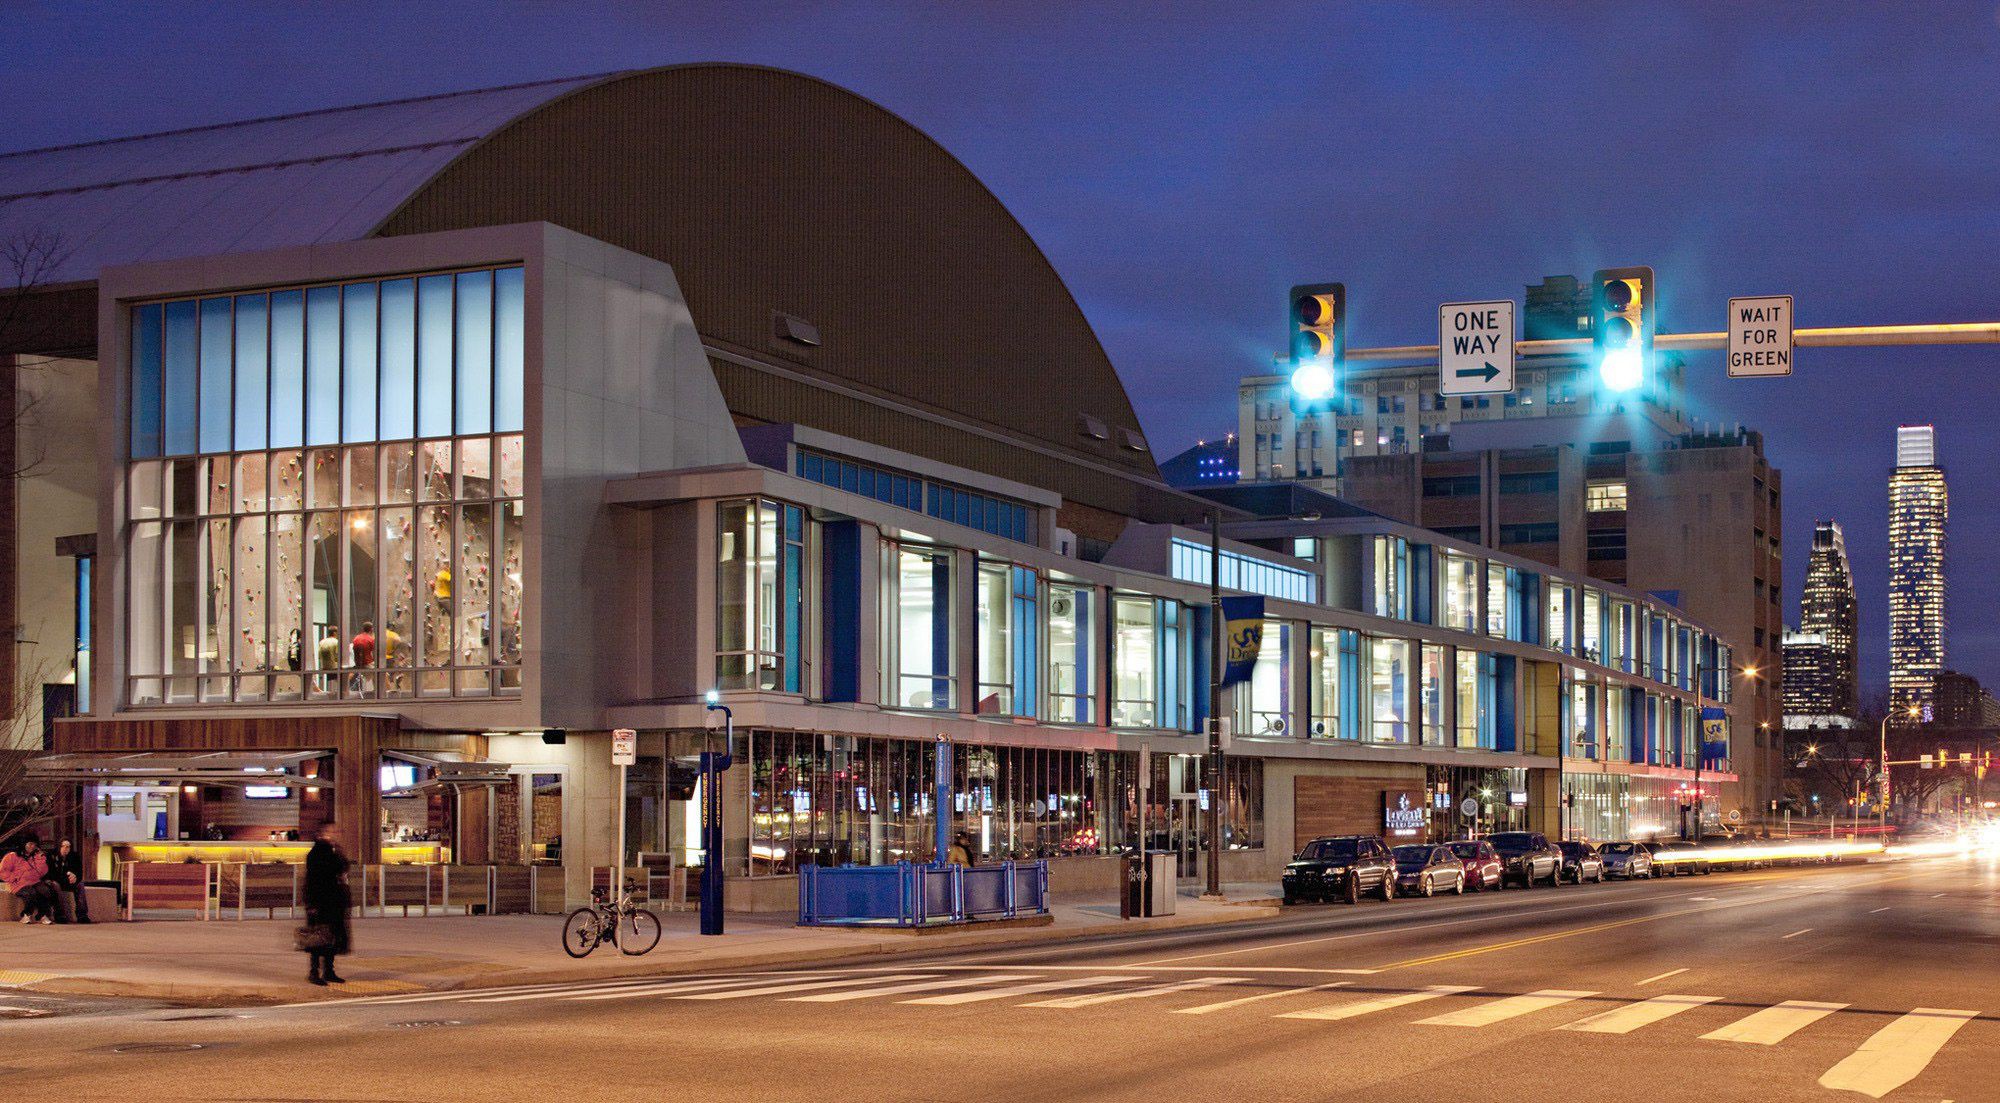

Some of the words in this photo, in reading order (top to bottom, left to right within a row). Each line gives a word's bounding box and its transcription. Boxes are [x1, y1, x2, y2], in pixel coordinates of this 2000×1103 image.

[1454, 310, 1499, 331] ONE
[1741, 307, 1781, 322] WAIT
[1453, 334, 1501, 355] WAY
[1743, 329, 1777, 344] FOR
[1731, 350, 1788, 367] GREEN
